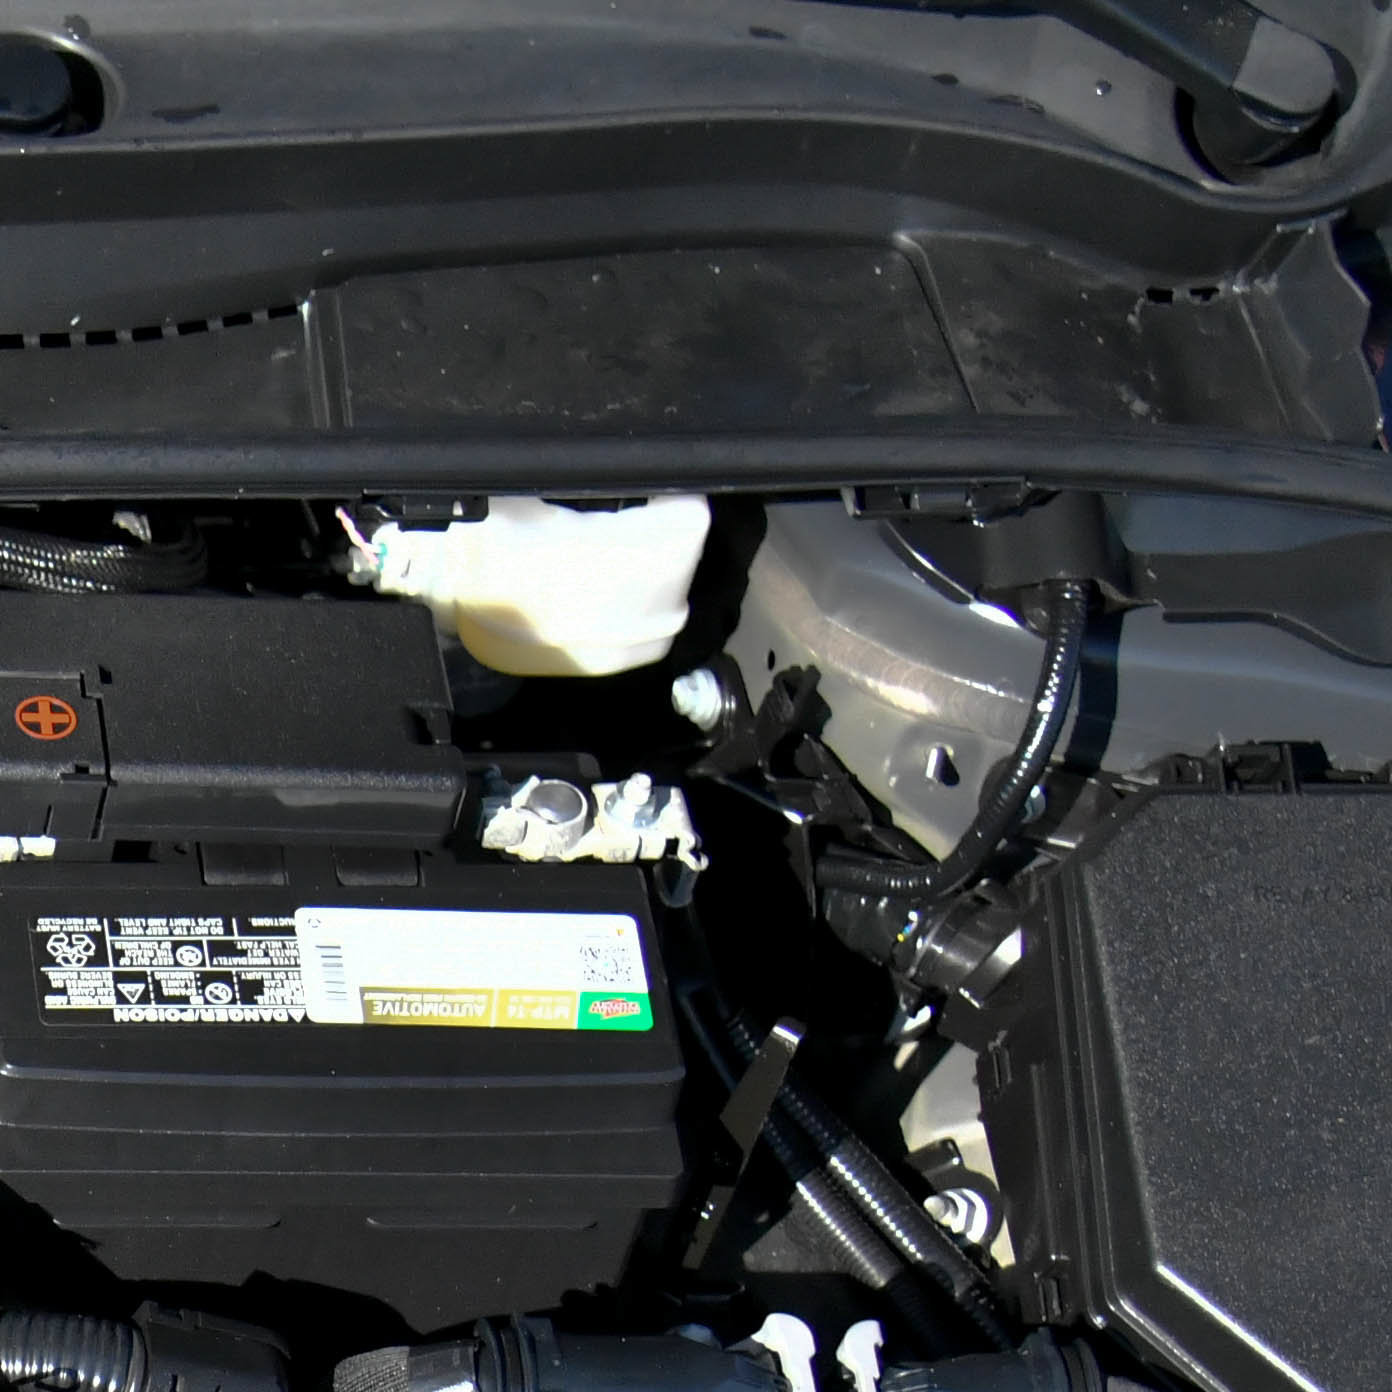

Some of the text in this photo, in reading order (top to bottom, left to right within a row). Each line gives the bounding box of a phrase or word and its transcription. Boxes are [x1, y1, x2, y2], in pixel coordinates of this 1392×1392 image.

[132, 957, 150, 965] OUT
[152, 957, 174, 965] KEEP
[212, 957, 271, 965] IMMEDIATELY
[372, 1001, 487, 1017] AUTOMOTIVE
[114, 1009, 288, 1022] DANGER/POISON
